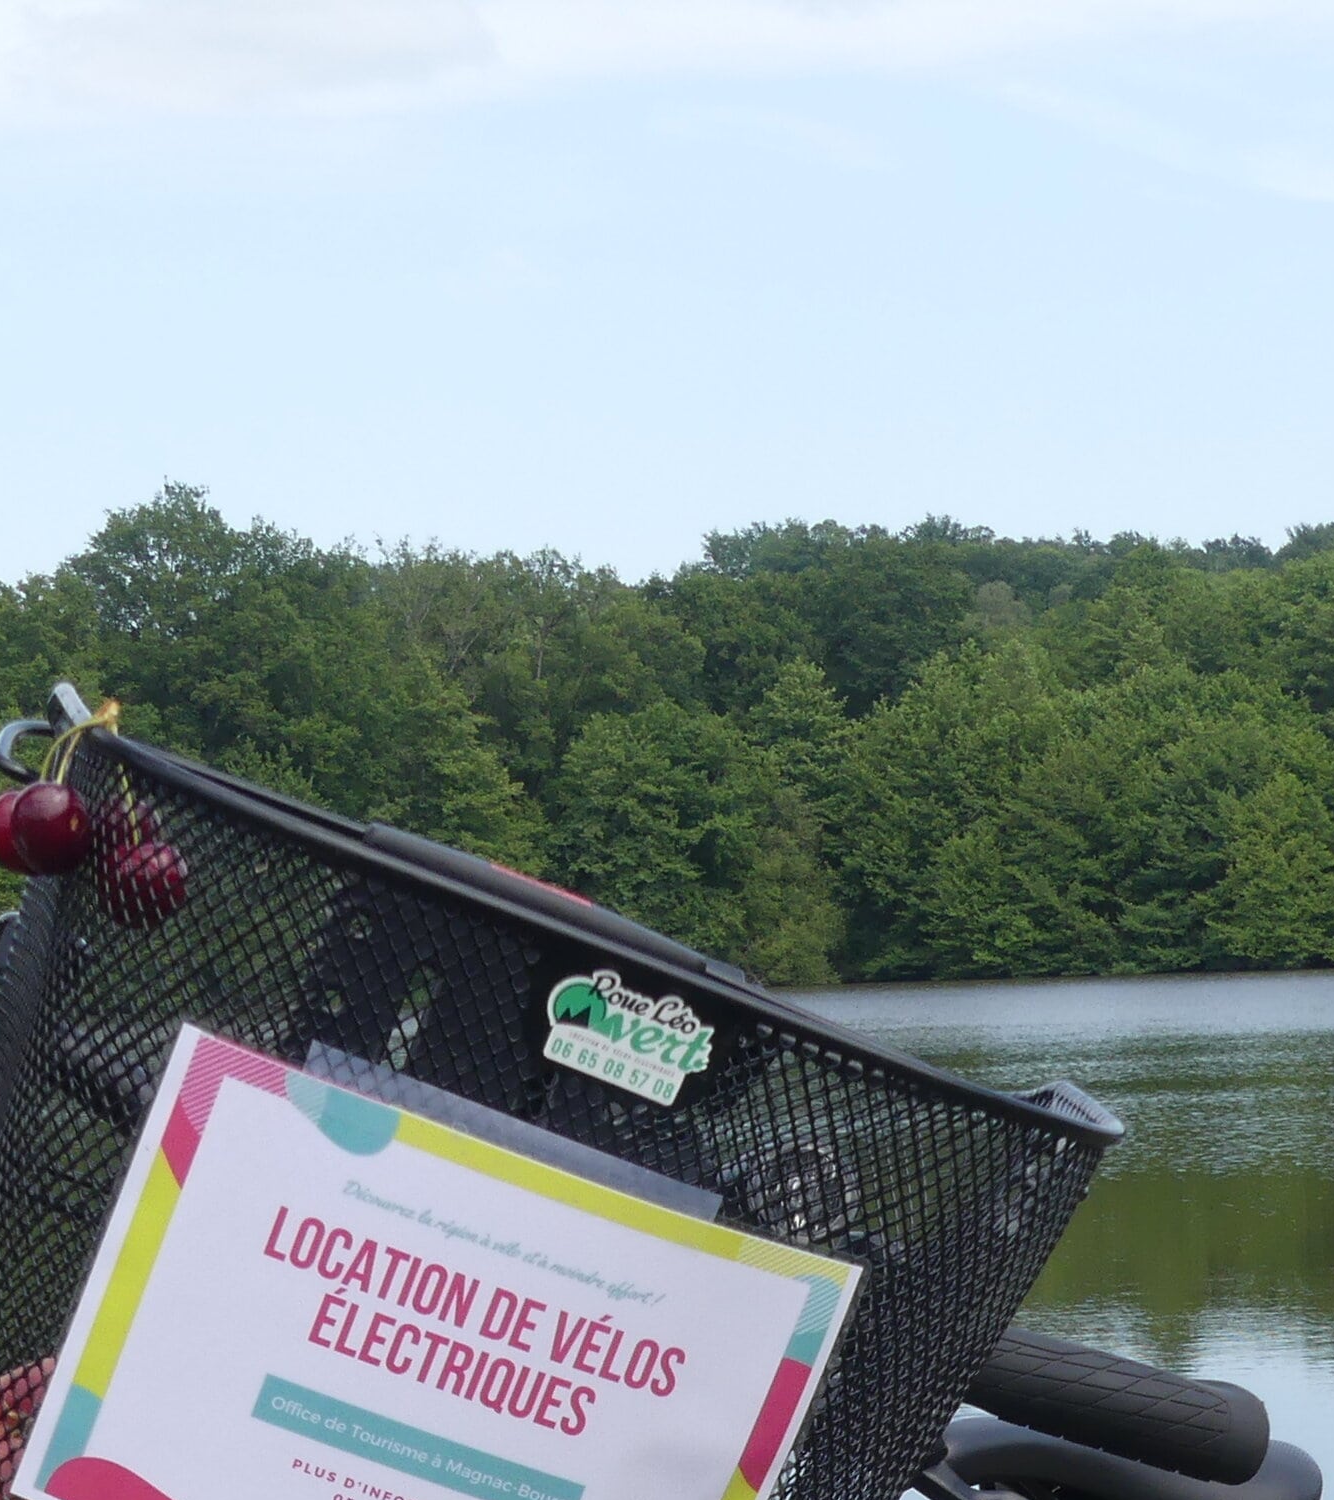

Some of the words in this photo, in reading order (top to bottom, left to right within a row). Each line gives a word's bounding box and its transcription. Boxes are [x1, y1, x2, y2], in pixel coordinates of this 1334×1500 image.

[588, 975, 651, 1015] Roue
[650, 1000, 696, 1034] Léo
[551, 1037, 573, 1059] 06
[577, 1048, 599, 1069] 65
[603, 1058, 625, 1078] 08
[628, 1068, 650, 1089] 57
[652, 1079, 675, 1099] 08
[263, 1205, 480, 1329] LOCATION
[479, 1286, 548, 1354] DE
[550, 1310, 687, 1398] VÉLOS
[307, 1287, 597, 1437] ÉLECTRIQUES
[271, 1396, 322, 1424] Office
[324, 1416, 347, 1434] de
[351, 1424, 429, 1463] Tourisme
[431, 1453, 442, 1468] à
[292, 1458, 338, 1483] PLUS
